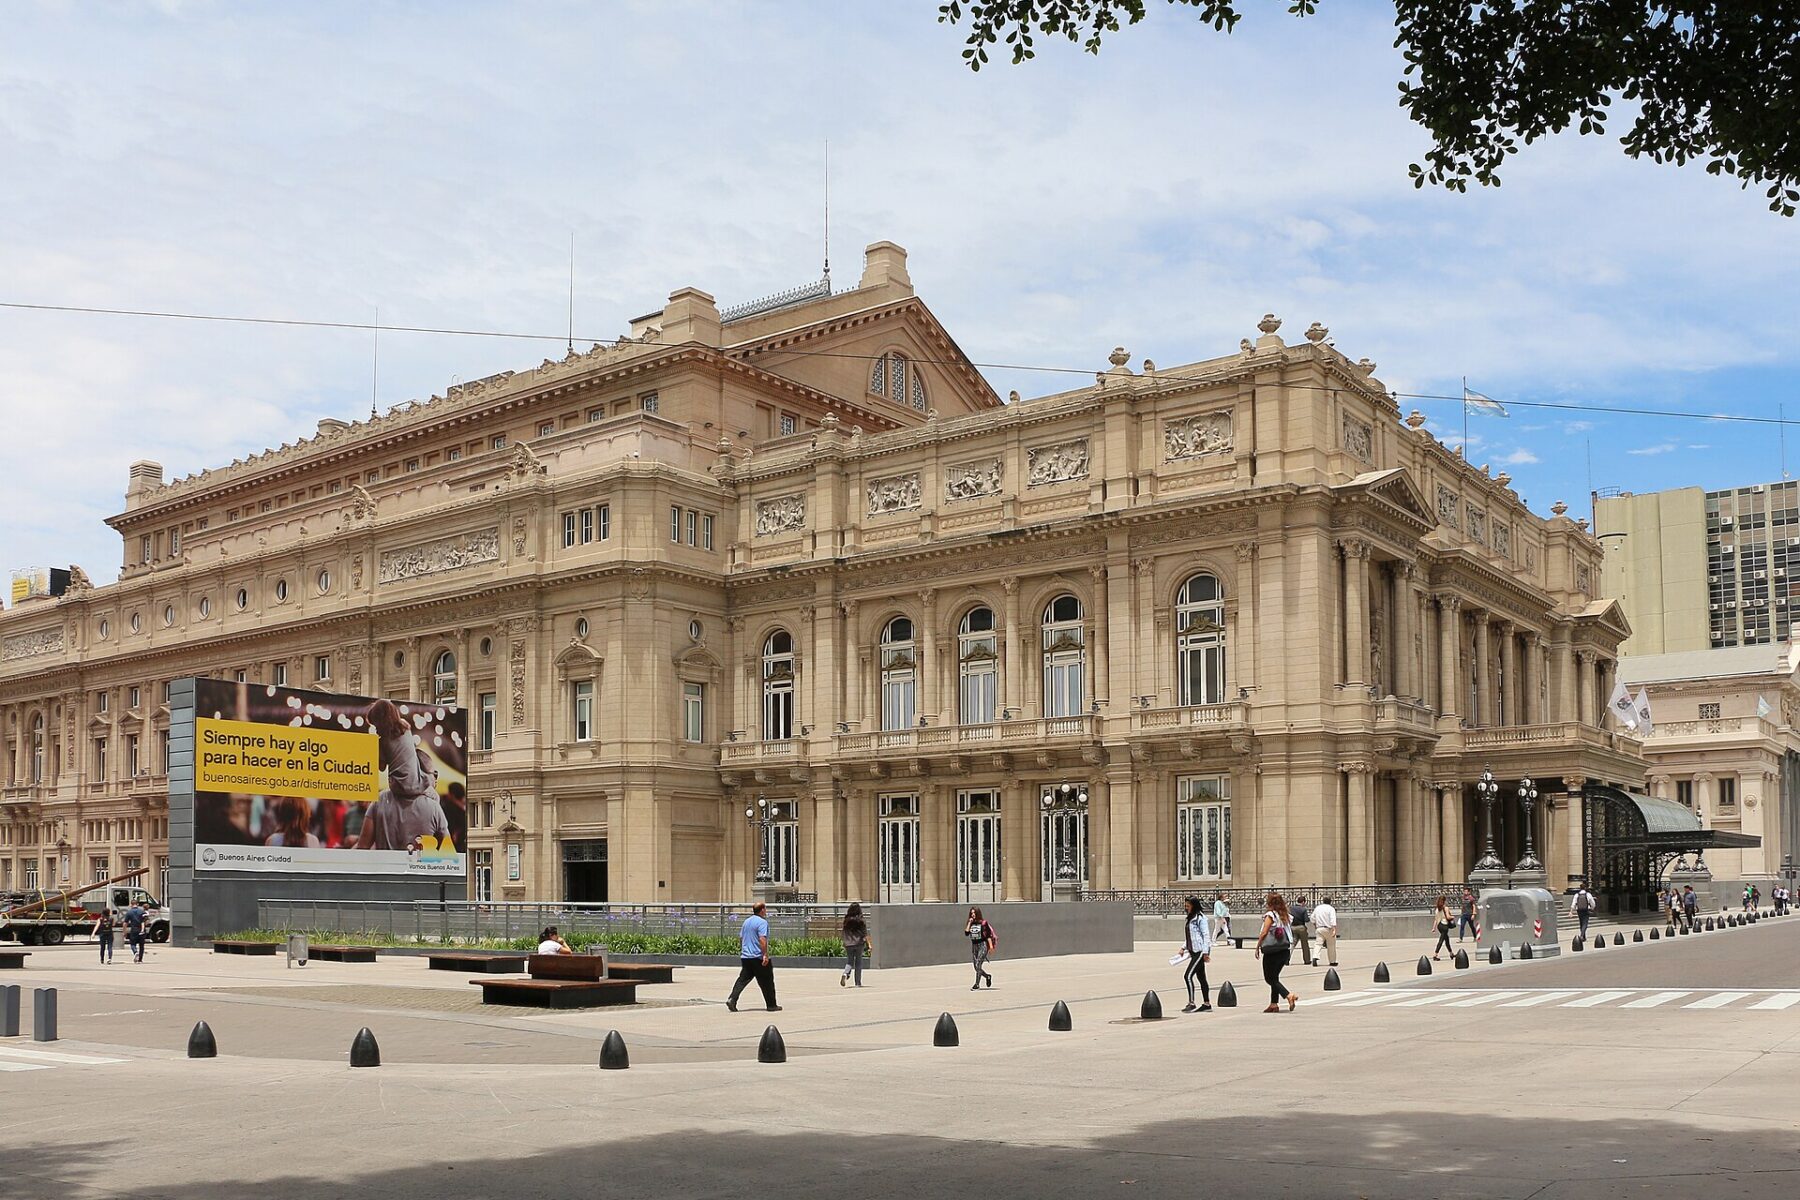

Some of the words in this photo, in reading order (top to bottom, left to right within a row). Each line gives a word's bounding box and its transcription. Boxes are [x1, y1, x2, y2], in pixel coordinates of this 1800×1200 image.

[203, 729, 265, 751] Siempre
[269, 734, 295, 755] hay
[298, 738, 328, 757] algo
[203, 752, 237, 767] para
[241, 751, 283, 768] hacer
[286, 759, 304, 770] en
[307, 757, 319, 772] la
[323, 758, 373, 775] Ciudad.
[202, 771, 372, 793] buenosaires.gob.ar/disfrutemosBA
[218, 853, 245, 861] Buenos
[246, 854, 265, 862] Aires
[266, 854, 292, 863] Ciudad
